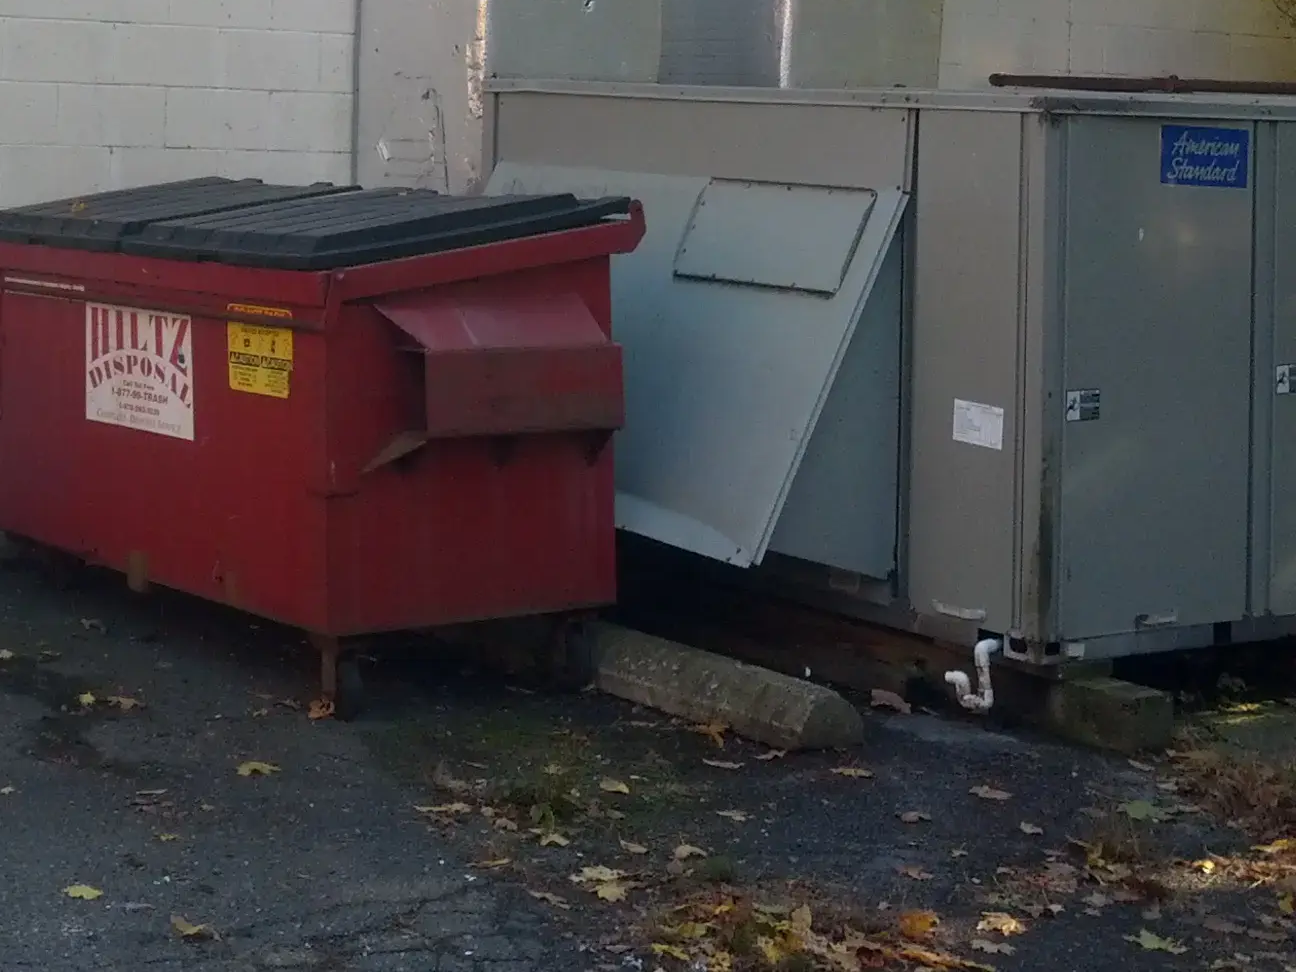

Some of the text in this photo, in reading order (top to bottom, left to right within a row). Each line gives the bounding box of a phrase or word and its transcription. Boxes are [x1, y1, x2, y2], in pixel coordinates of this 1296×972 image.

[1171, 130, 1240, 158] American
[1166, 157, 1240, 182] Standard
[90, 307, 189, 377] HILTZ
[88, 354, 191, 408] DISPOSAL
